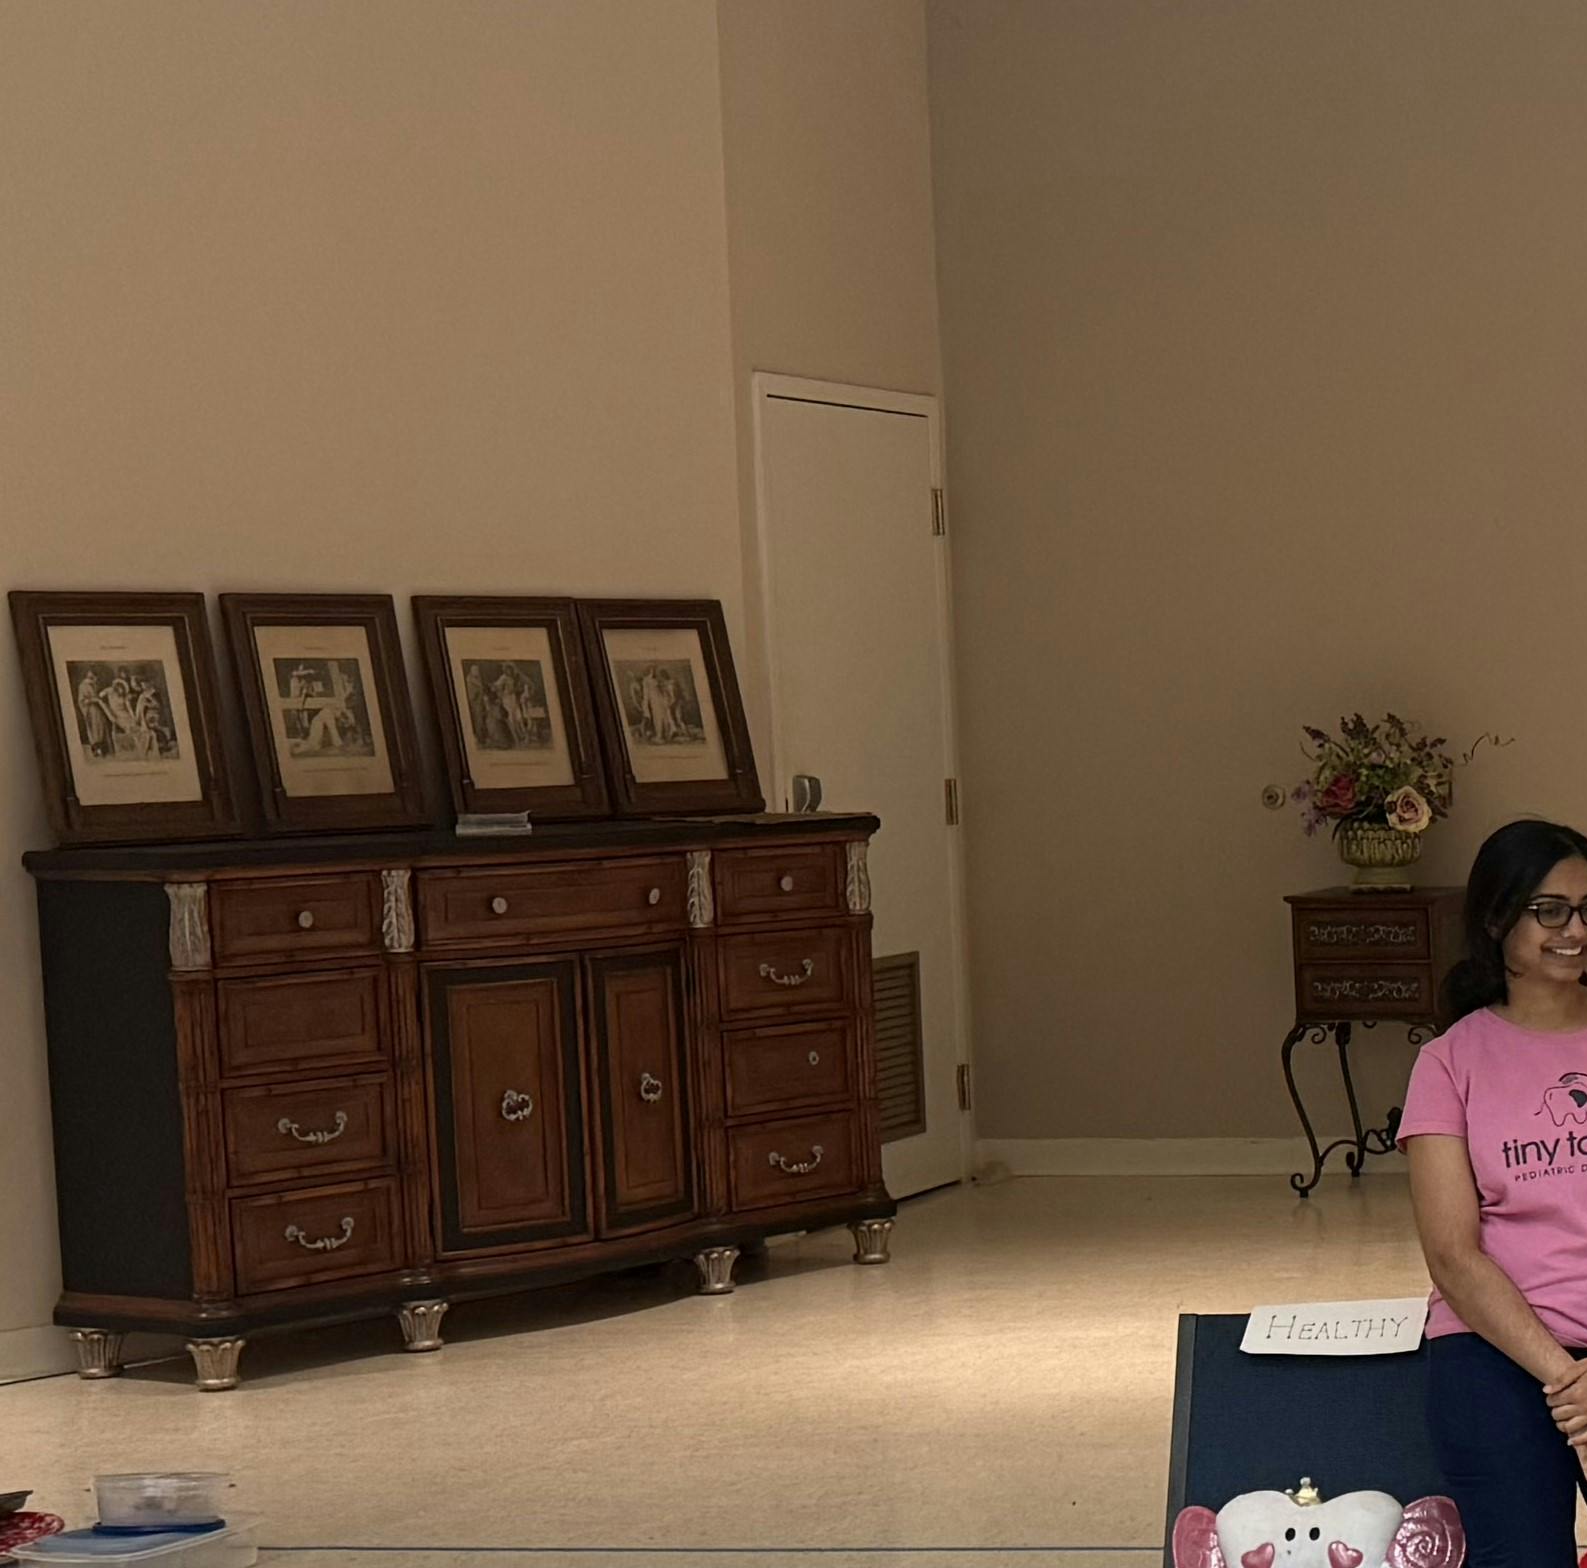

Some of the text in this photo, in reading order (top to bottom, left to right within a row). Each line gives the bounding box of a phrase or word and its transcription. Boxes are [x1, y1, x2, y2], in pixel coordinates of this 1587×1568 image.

[1502, 1138, 1560, 1168] tiny
[1514, 1165, 1575, 1182] PEDIATRIC
[1266, 1315, 1408, 1340] HEALTHY
